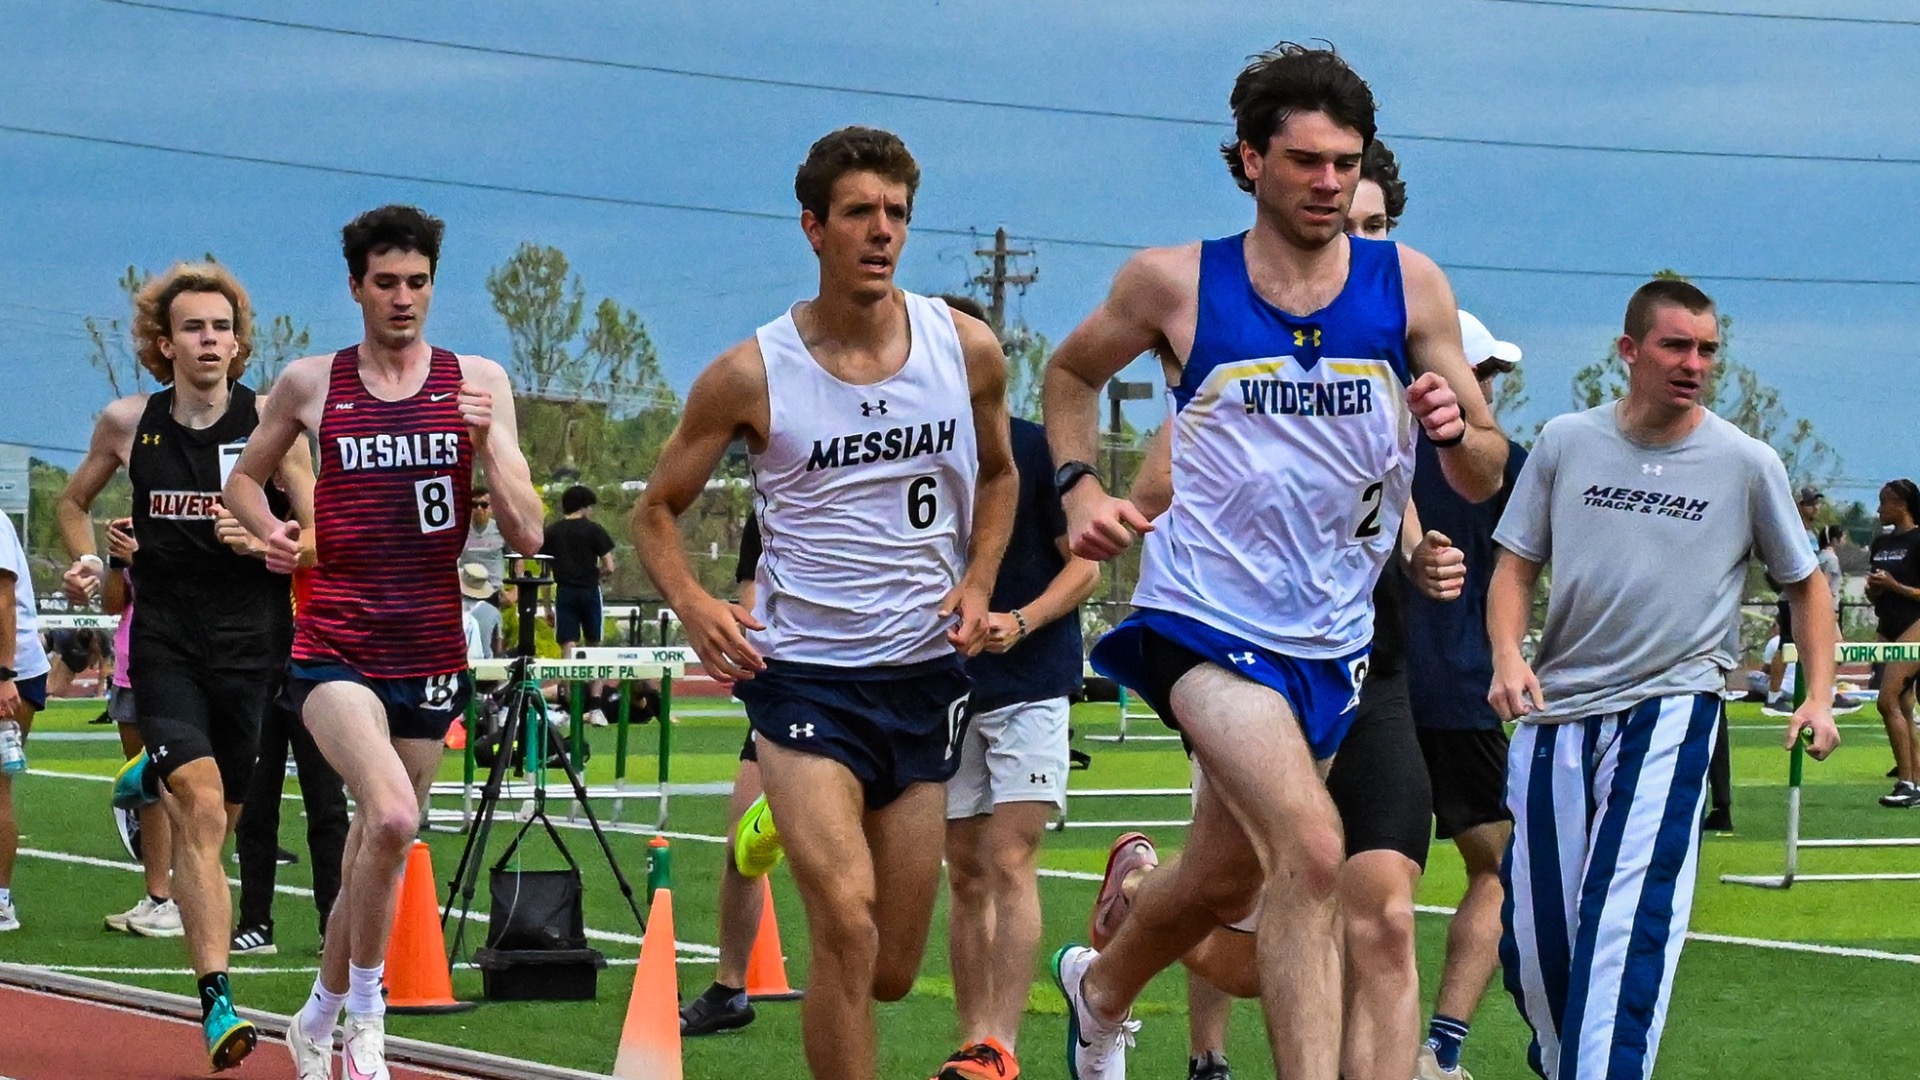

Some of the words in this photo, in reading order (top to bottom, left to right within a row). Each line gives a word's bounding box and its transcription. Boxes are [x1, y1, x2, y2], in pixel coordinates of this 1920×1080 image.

[335, 402, 355, 410] MAC
[1240, 378, 1373, 417] WIDENER
[337, 433, 459, 470] DESALES
[806, 418, 956, 472] MESSIAH
[422, 482, 450, 528] 8
[907, 476, 937, 529] 6
[1354, 481, 1383, 538] 2
[1582, 485, 1709, 513] MESSIAH
[1584, 497, 1637, 512] TRACK
[1640, 505, 1652, 514] &
[1657, 507, 1703, 521] FIELD
[73, 617, 100, 627] YORK
[652, 650, 685, 662] YORK
[1840, 646, 1877, 662] YORK
[1883, 646, 1920, 662] COLL
[541, 665, 595, 679] COLLEGE
[598, 665, 613, 679] OF
